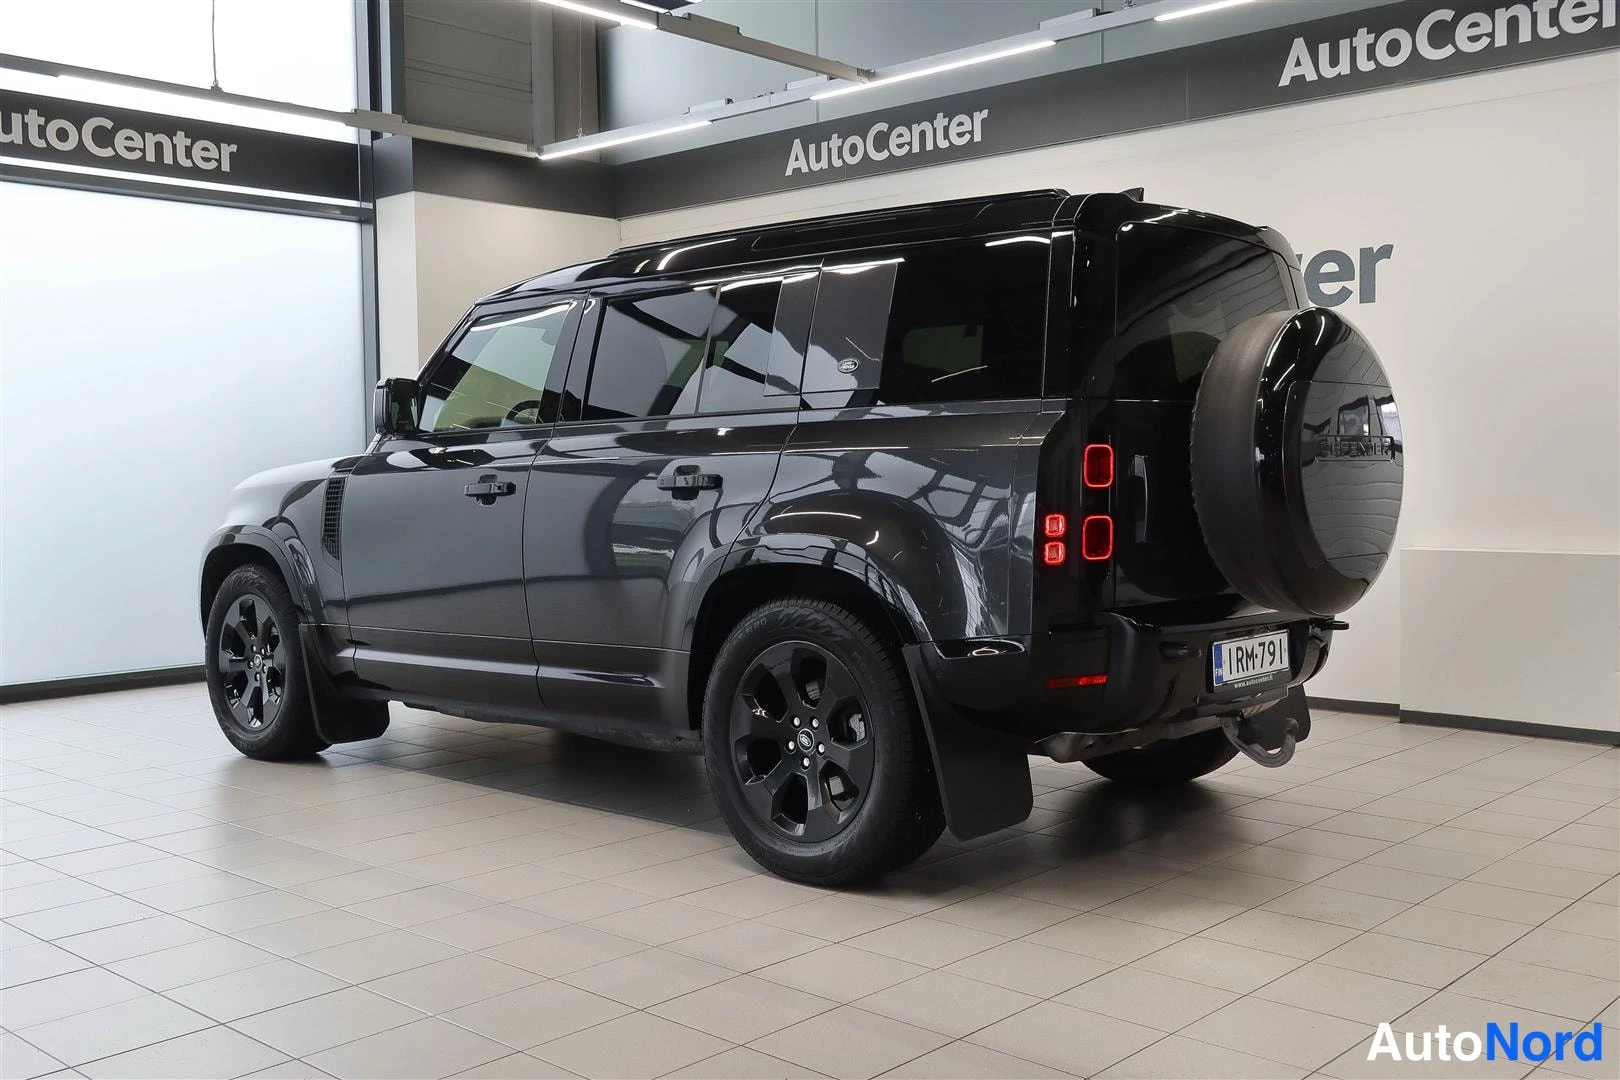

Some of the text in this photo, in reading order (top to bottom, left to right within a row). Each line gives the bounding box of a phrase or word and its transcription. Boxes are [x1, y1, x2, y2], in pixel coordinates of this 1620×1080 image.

[0, 109, 238, 173] utoCenter
[784, 109, 989, 177] AutoCenter
[1296, 244, 1394, 308] er
[1228, 638, 1283, 675] IRM-791
